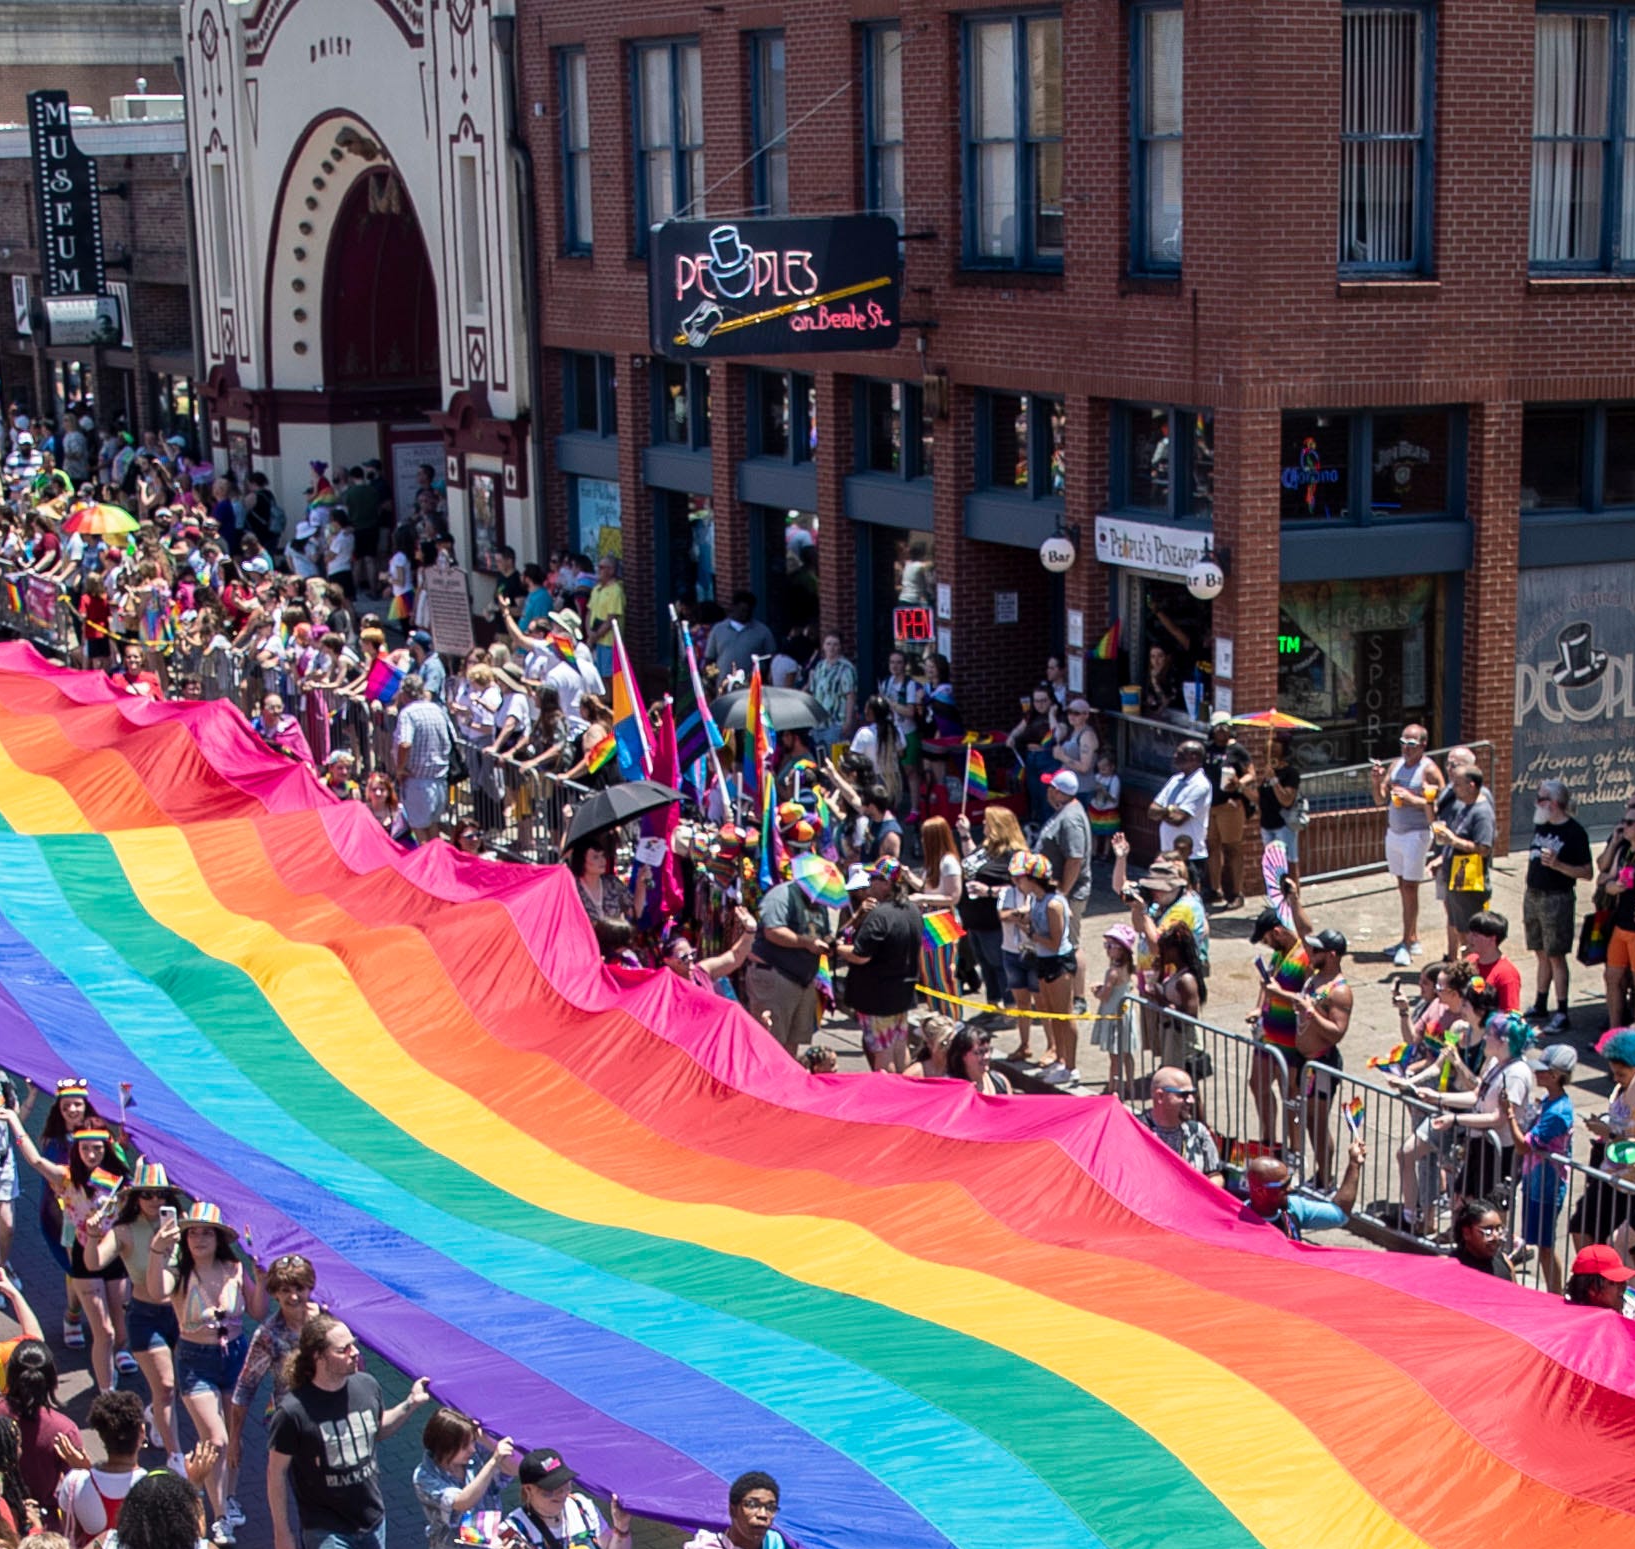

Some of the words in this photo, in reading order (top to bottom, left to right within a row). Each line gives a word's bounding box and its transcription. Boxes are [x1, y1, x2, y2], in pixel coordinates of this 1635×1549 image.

[43, 102, 82, 292] MUSEUM
[817, 304, 866, 331] Beale
[1048, 550, 1070, 563] Bar
[1154, 535, 1200, 569] PINEAPP
[895, 608, 934, 640] OPEN
[1318, 605, 1409, 631] CIGARS
[1277, 636, 1300, 653] TM
[1528, 751, 1588, 772] Home
[1593, 750, 1615, 771] of
[1596, 766, 1633, 790] Year
[326, 1470, 363, 1488] BLACK
